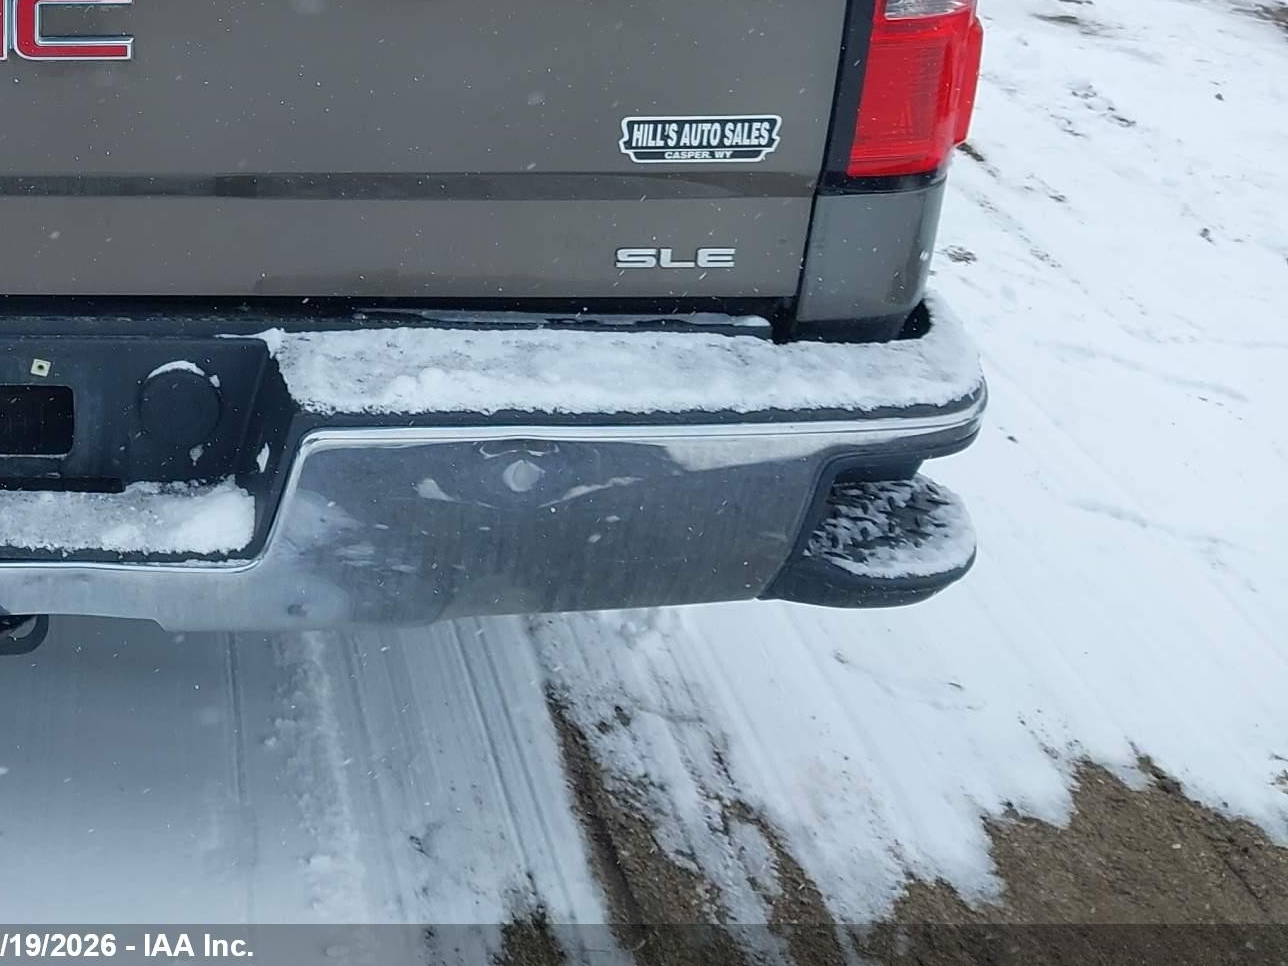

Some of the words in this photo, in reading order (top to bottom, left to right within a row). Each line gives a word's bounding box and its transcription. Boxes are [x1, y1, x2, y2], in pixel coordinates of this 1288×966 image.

[631, 123, 678, 147] HILL'S
[679, 123, 721, 147] AUTO
[723, 122, 770, 146] SALES
[714, 150, 734, 159] WY
[616, 248, 736, 268] SLE
